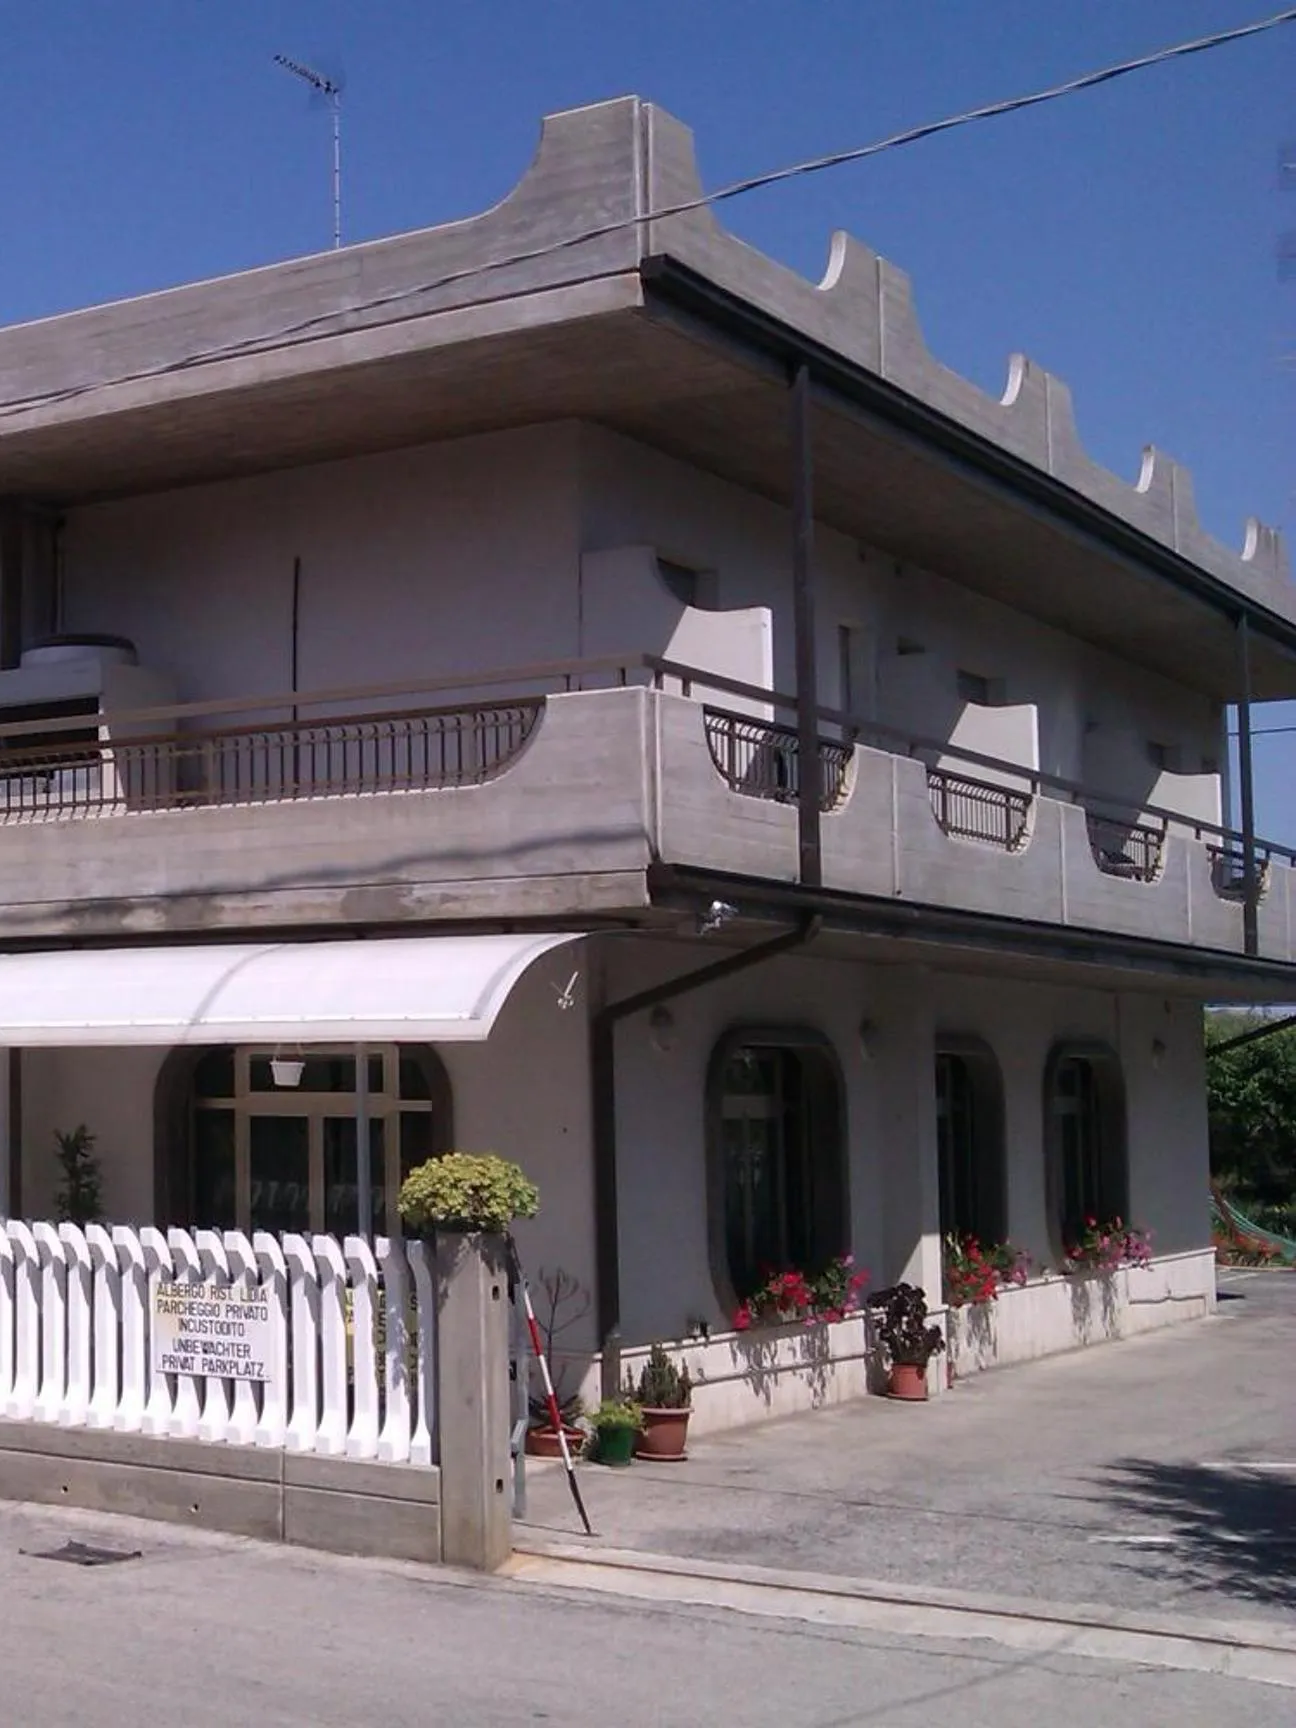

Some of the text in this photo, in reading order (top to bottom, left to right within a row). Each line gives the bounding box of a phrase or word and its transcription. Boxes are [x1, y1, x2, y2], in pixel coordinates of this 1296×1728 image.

[157, 1282, 205, 1299] ALBERGO
[157, 1299, 268, 1321] PARCHEGGIO PRIVATO
[178, 1318, 245, 1337] INCUSTODITO
[172, 1338, 251, 1359] UNBEWACHTER
[162, 1354, 264, 1377] PRIVAT PARKPLATZ
